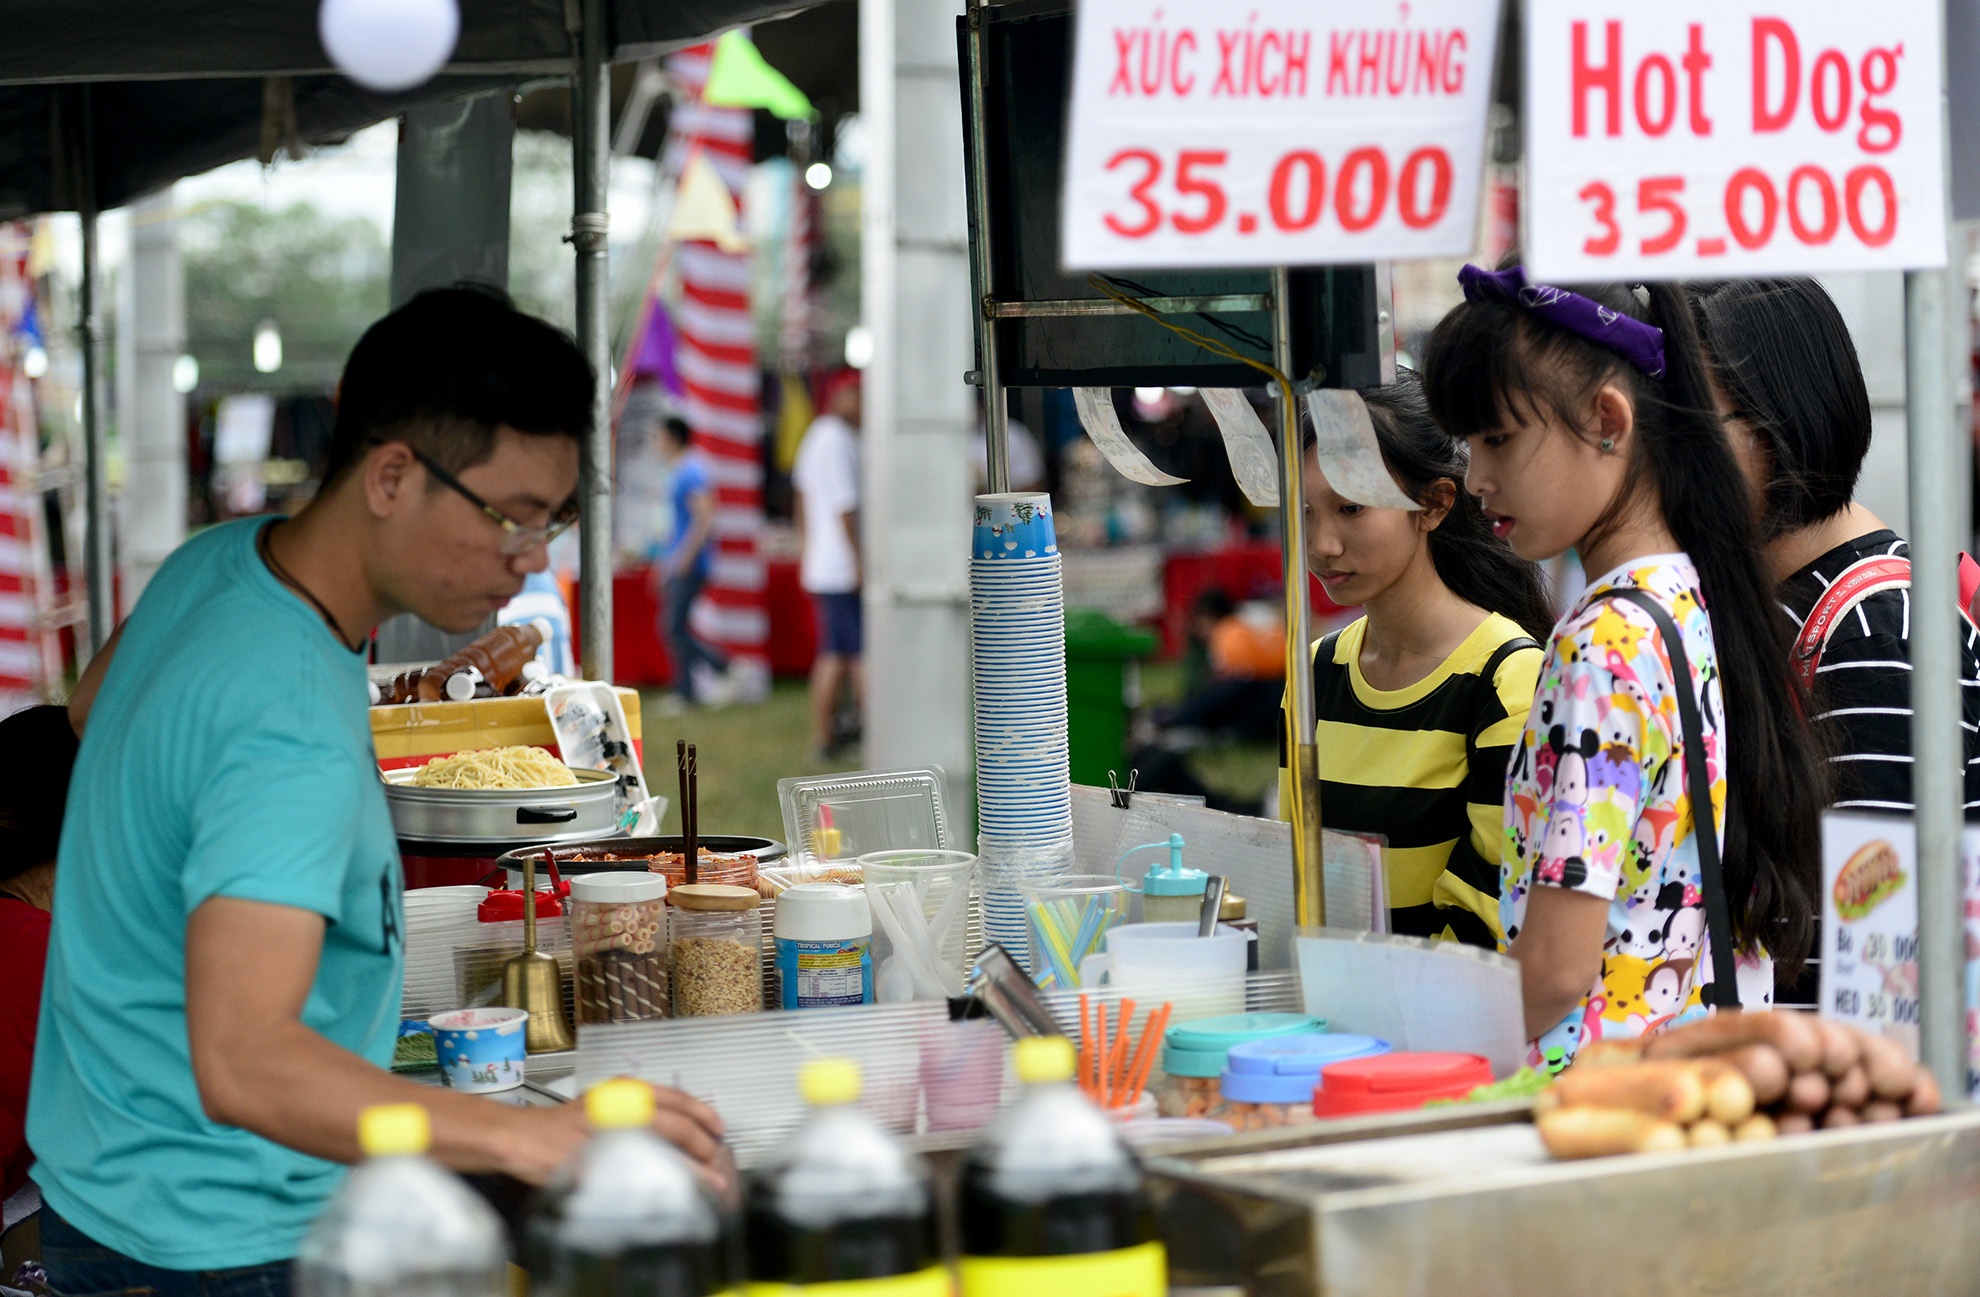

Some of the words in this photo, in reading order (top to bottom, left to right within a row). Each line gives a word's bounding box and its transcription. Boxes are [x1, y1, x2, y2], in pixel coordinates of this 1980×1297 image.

[1108, 10, 1198, 98] XÚC
[1210, 11, 1312, 98] XÍCH
[1570, 19, 1714, 139] Hot
[1750, 15, 1905, 156] Dog
[1102, 144, 1455, 240] 35.000
[1807, 598, 1836, 644] SPORT
[797, 942, 821, 950] TROPICAL
[822, 942, 841, 950] PUNCH
